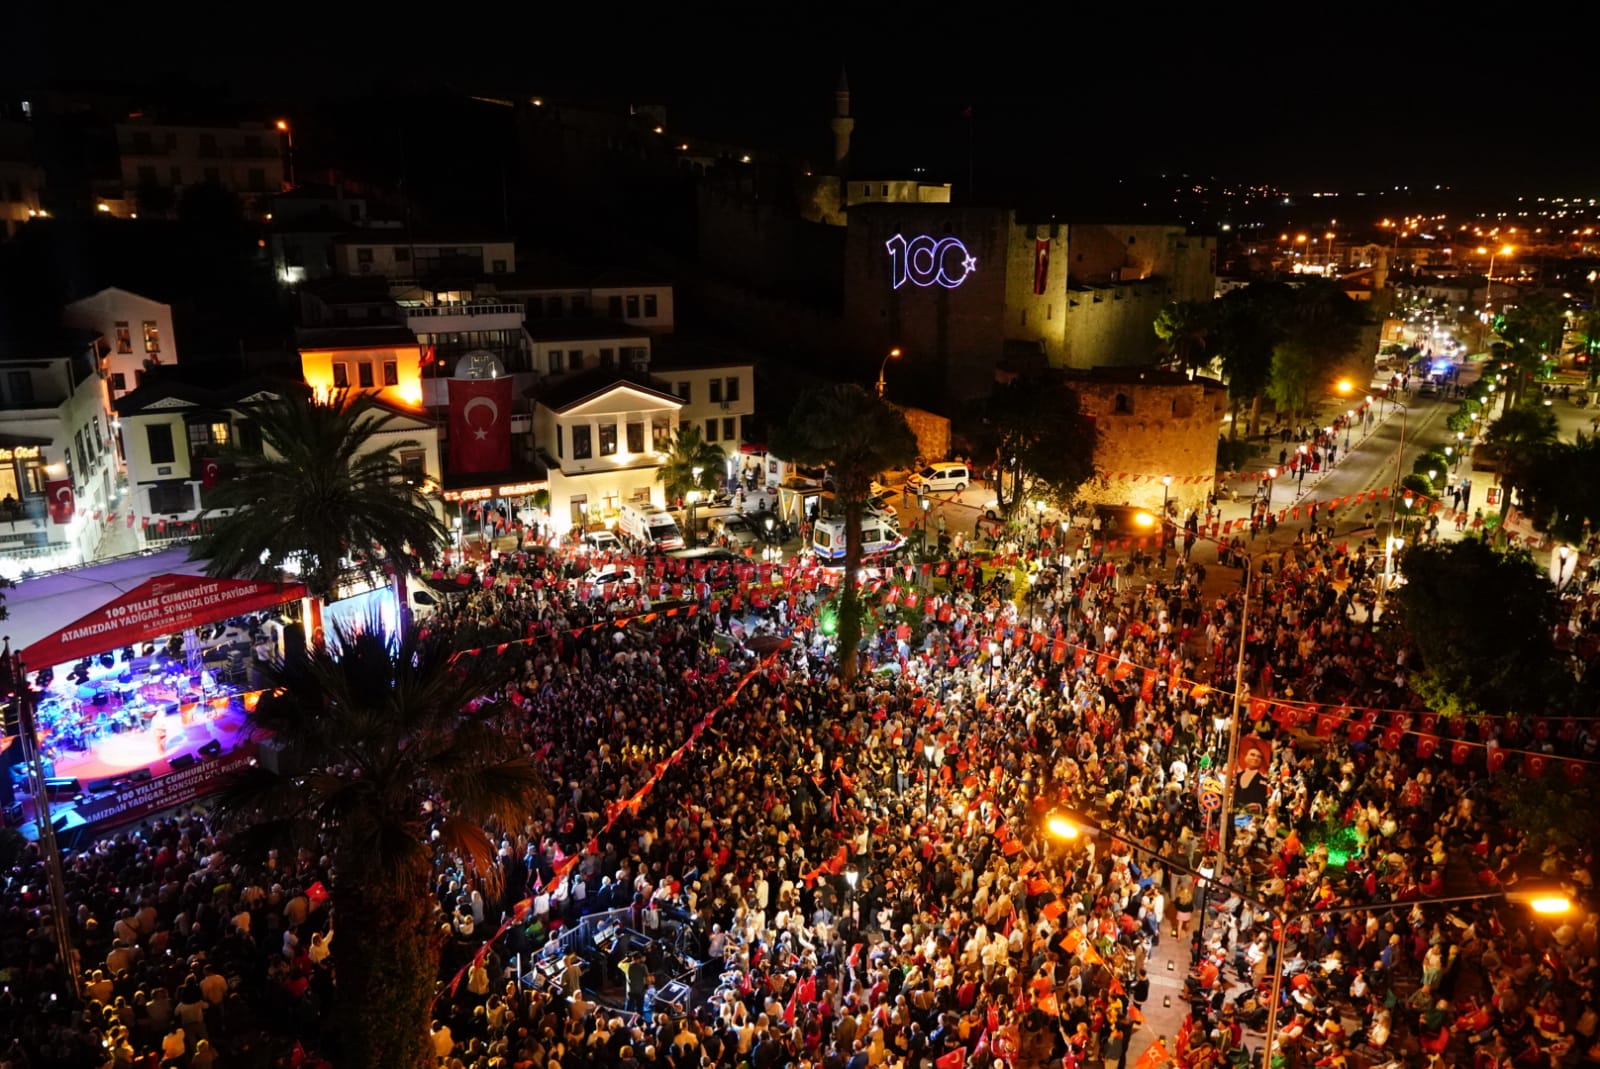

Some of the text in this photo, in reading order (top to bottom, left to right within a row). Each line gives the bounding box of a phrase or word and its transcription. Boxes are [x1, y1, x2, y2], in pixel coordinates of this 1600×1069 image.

[886, 233, 972, 289] 100
[61, 620, 118, 643] ATAMIZDAN
[163, 598, 203, 615] SONSUZA
[203, 593, 220, 605] DEK
[221, 584, 258, 601] PAYİDAR!
[105, 606, 126, 619] 100
[126, 597, 159, 613] YILLIK
[161, 583, 218, 604] CUMHURİYET
[116, 760, 219, 803] 100 YILLIK CUMHURİYET
[168, 774, 204, 793] SONSUZA
